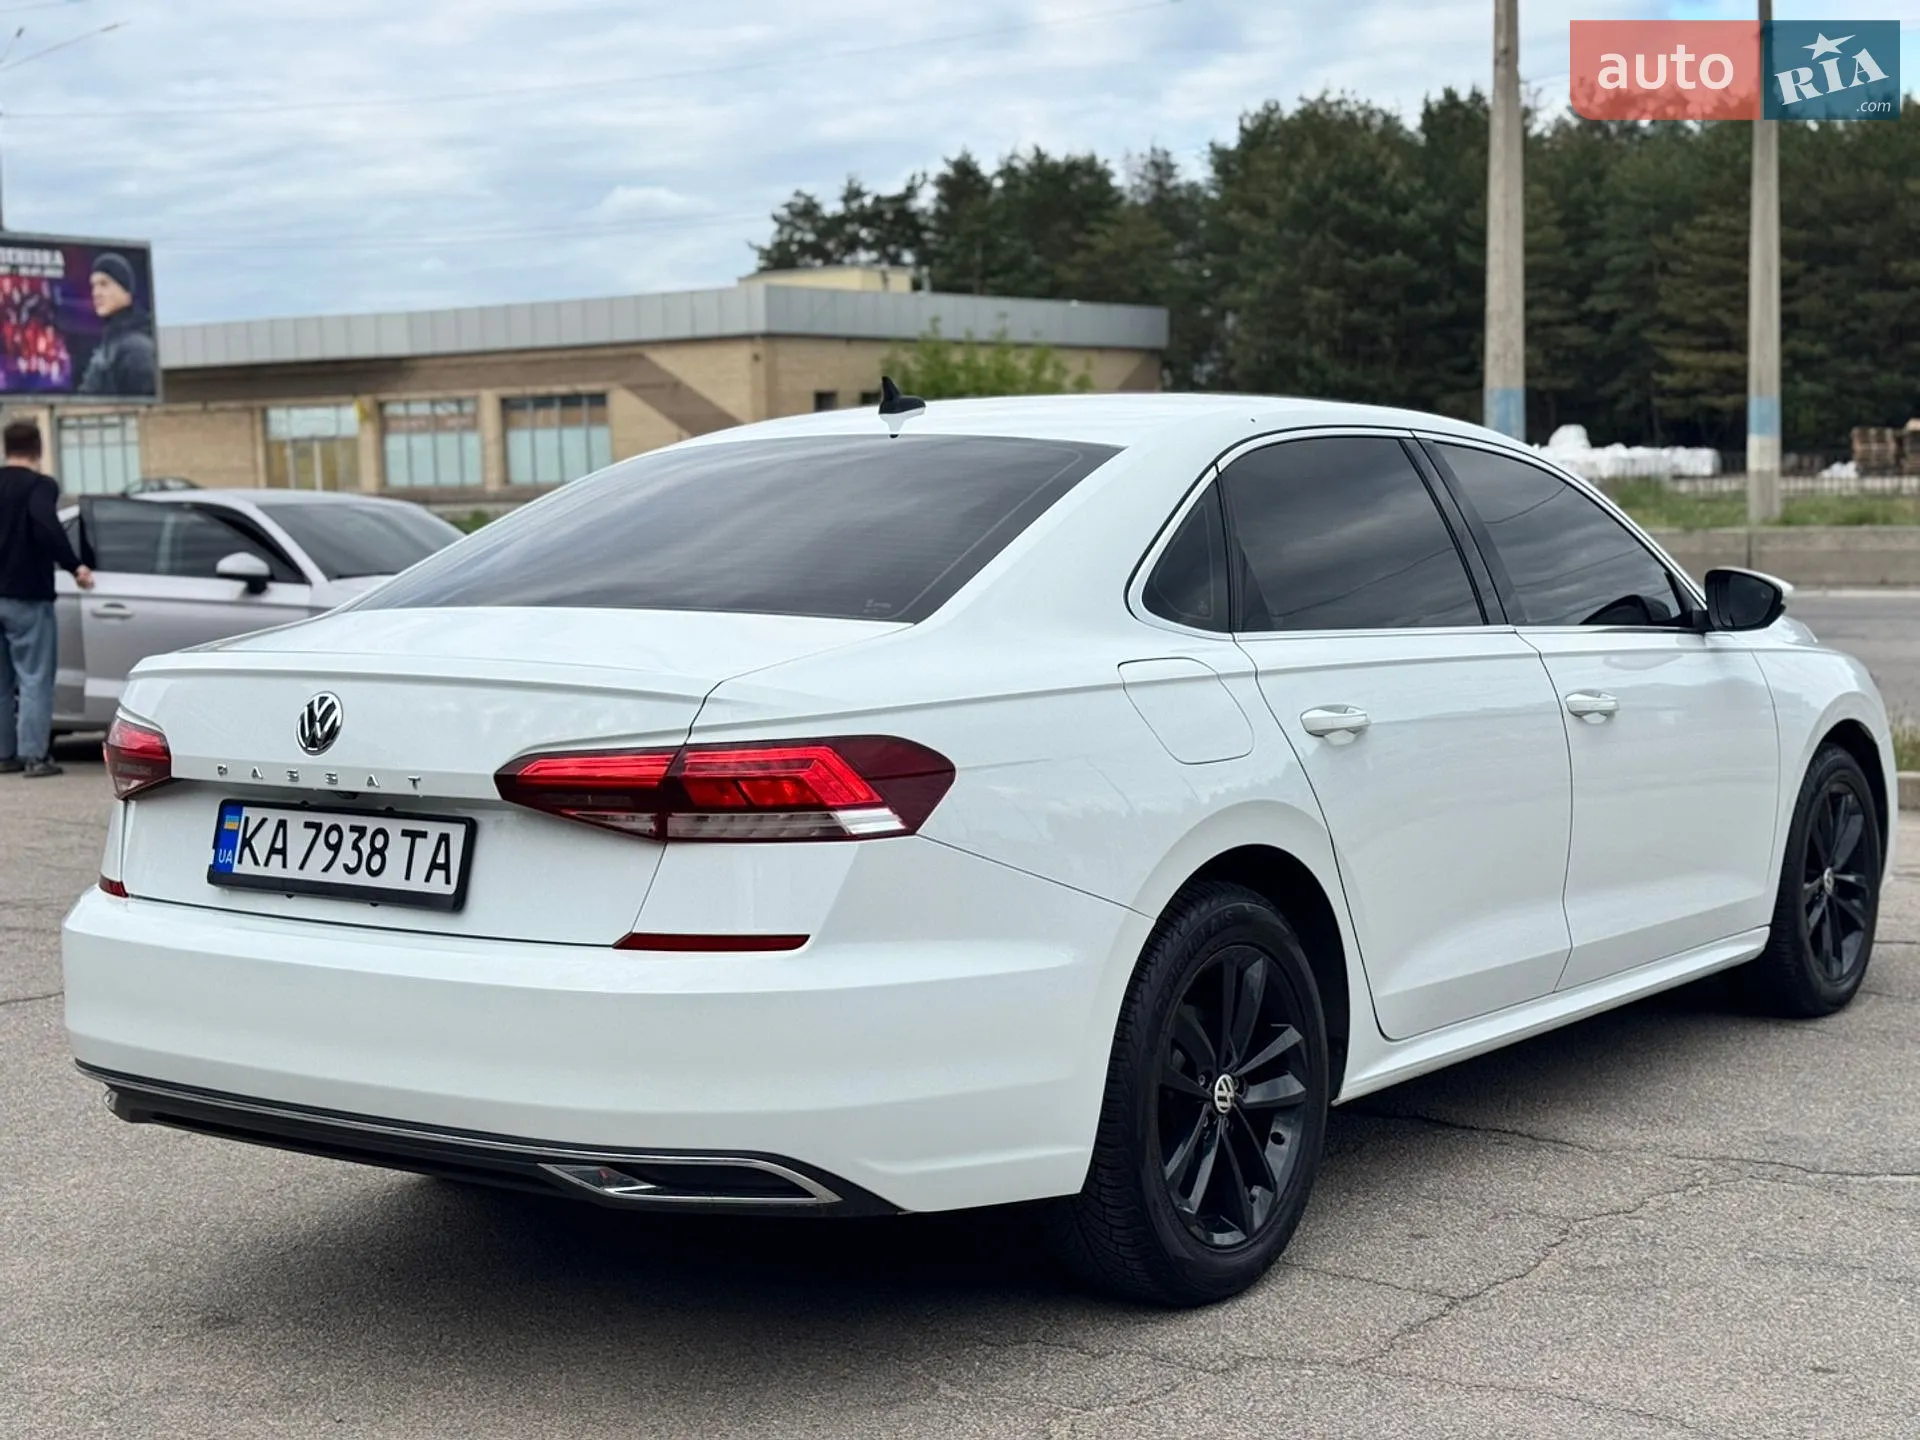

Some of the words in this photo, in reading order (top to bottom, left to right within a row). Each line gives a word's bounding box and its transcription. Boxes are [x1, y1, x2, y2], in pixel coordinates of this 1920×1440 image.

[217, 763, 422, 790] PASSAT
[218, 848, 233, 864] UA
[237, 816, 288, 869] KA
[298, 821, 389, 878] 7938
[401, 829, 451, 886] TA
